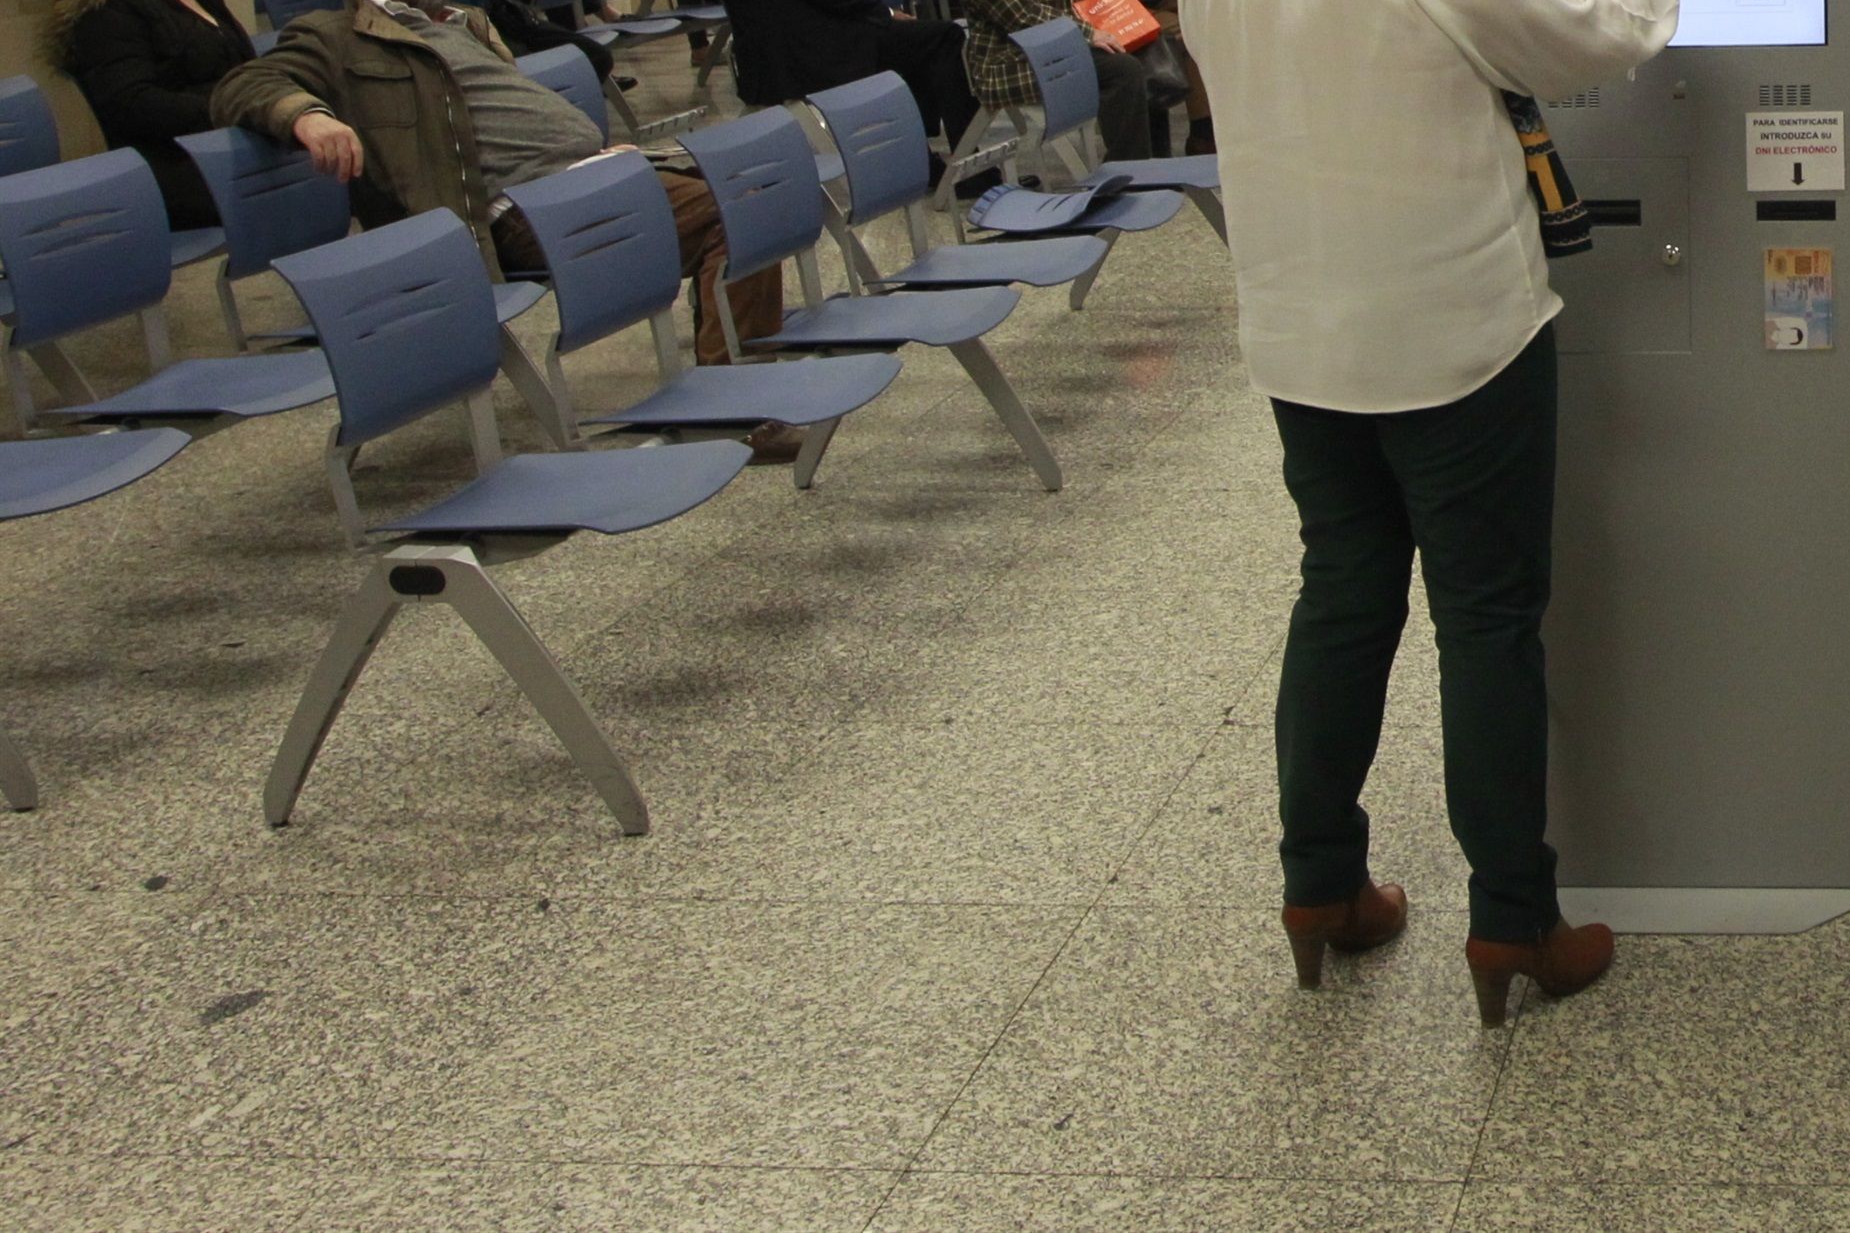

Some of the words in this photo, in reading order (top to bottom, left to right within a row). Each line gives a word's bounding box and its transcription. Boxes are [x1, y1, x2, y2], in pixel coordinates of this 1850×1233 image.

[1779, 118, 1838, 126] IDENTIFICARSE
[1761, 132, 1819, 140] INTRODUZCA
[1755, 147, 1771, 155] DNI
[1773, 145, 1838, 155] ELECTRÓNICO
